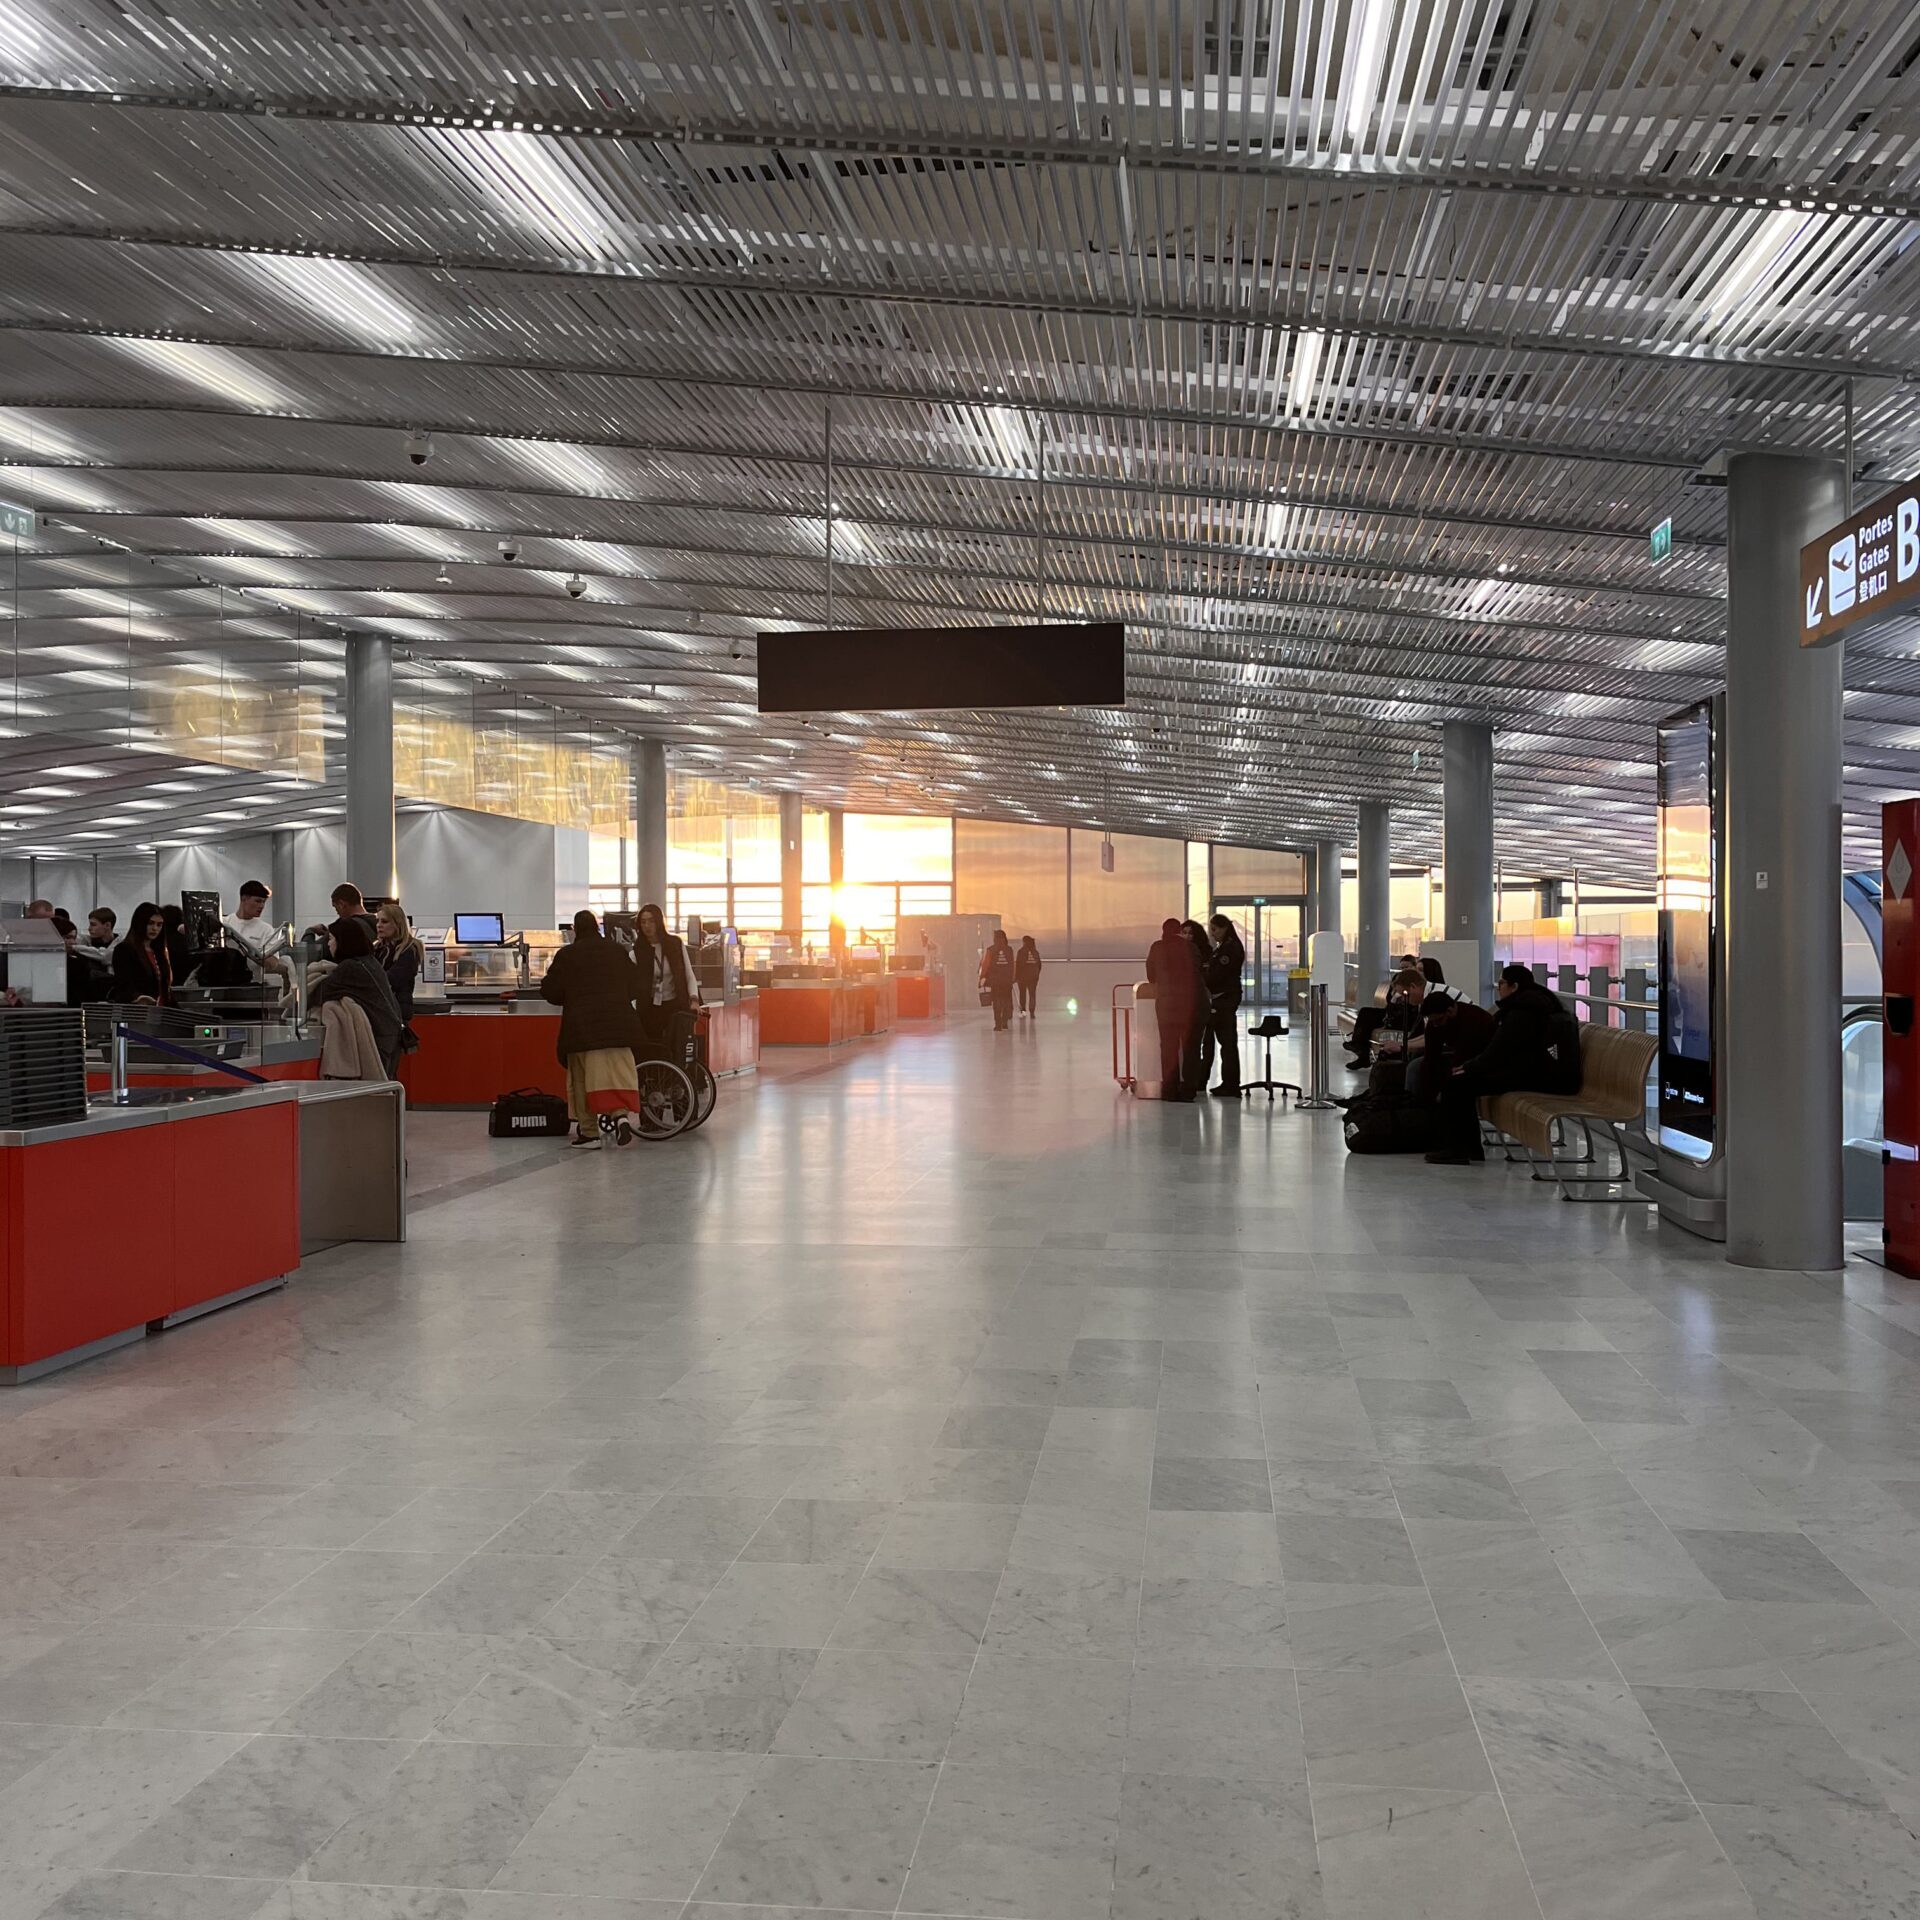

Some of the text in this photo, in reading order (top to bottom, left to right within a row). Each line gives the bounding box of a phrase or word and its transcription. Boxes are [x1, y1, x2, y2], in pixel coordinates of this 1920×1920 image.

[1859, 514, 1893, 548] Portes
[1897, 497, 1920, 583] B
[1859, 544, 1889, 574] Gates
[1859, 570, 1887, 603] 登机口
[511, 1115, 547, 1128] PUMA
